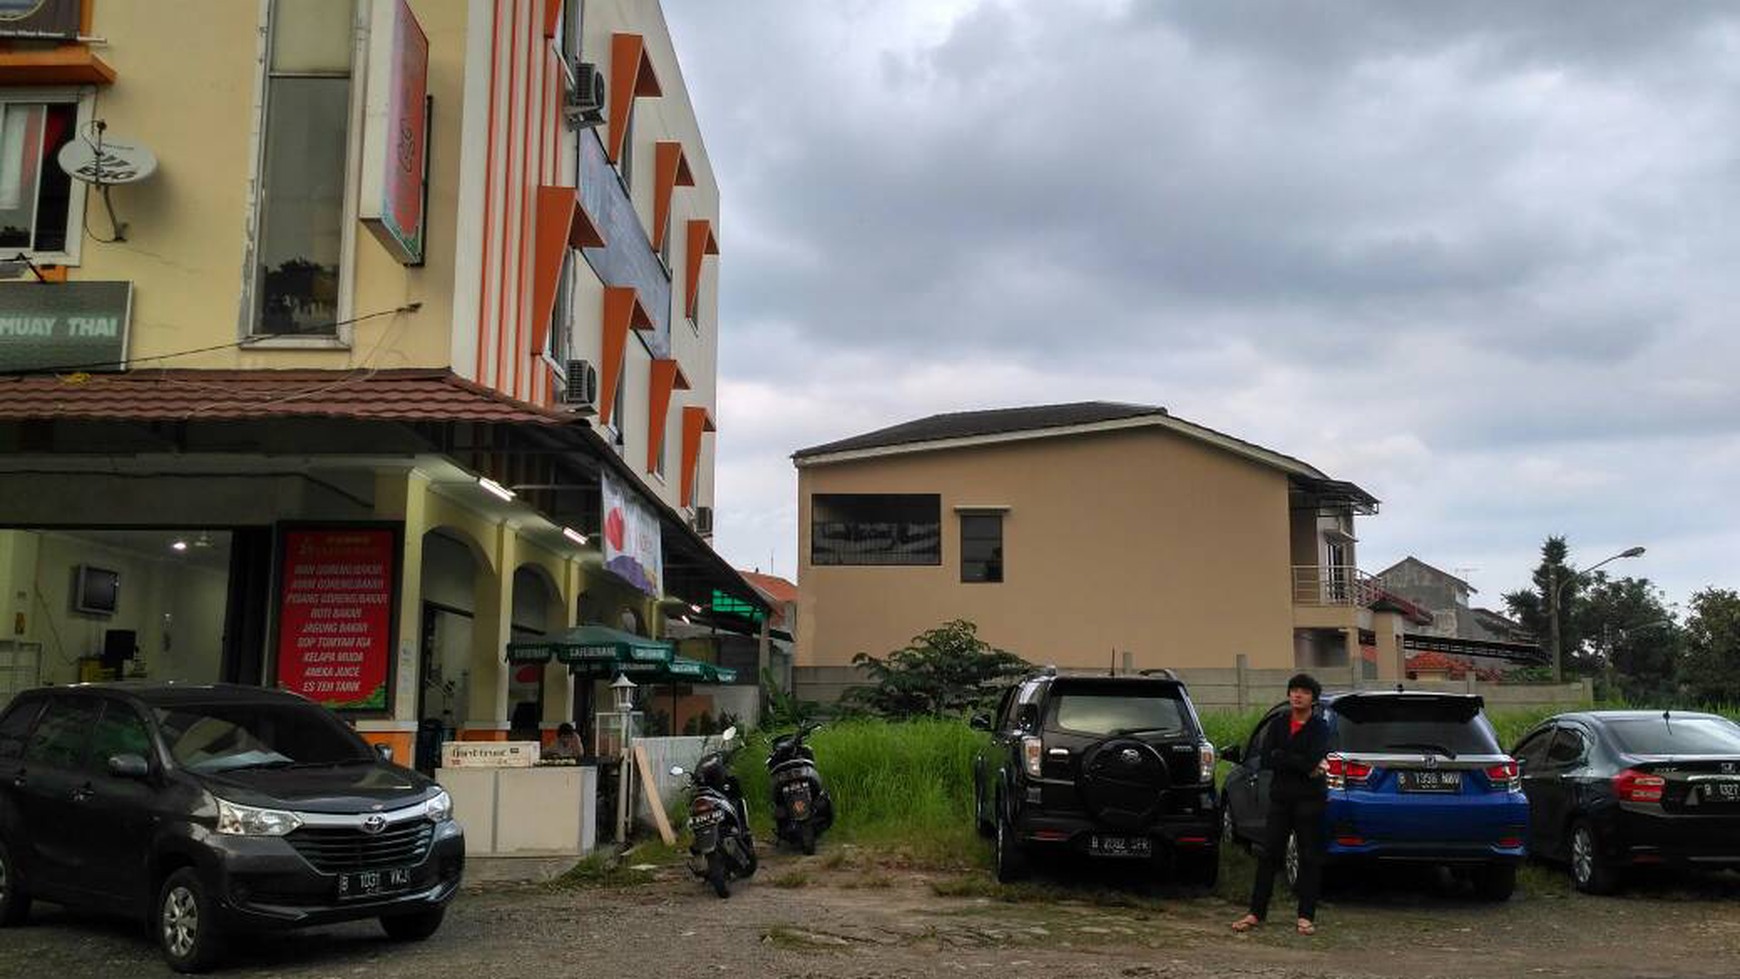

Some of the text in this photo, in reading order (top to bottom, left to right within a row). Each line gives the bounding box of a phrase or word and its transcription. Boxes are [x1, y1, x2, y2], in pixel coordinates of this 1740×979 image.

[0, 317, 118, 336] MUAY THAI
[310, 608, 331, 618] ROTI
[302, 623, 338, 633] JAGUNG
[297, 637, 371, 647] SOP TOMYAM IGA
[303, 652, 364, 662] KELAPA MUDA
[304, 667, 360, 677] ANEKA JUICE
[303, 682, 361, 692] ES TEH TARIK
